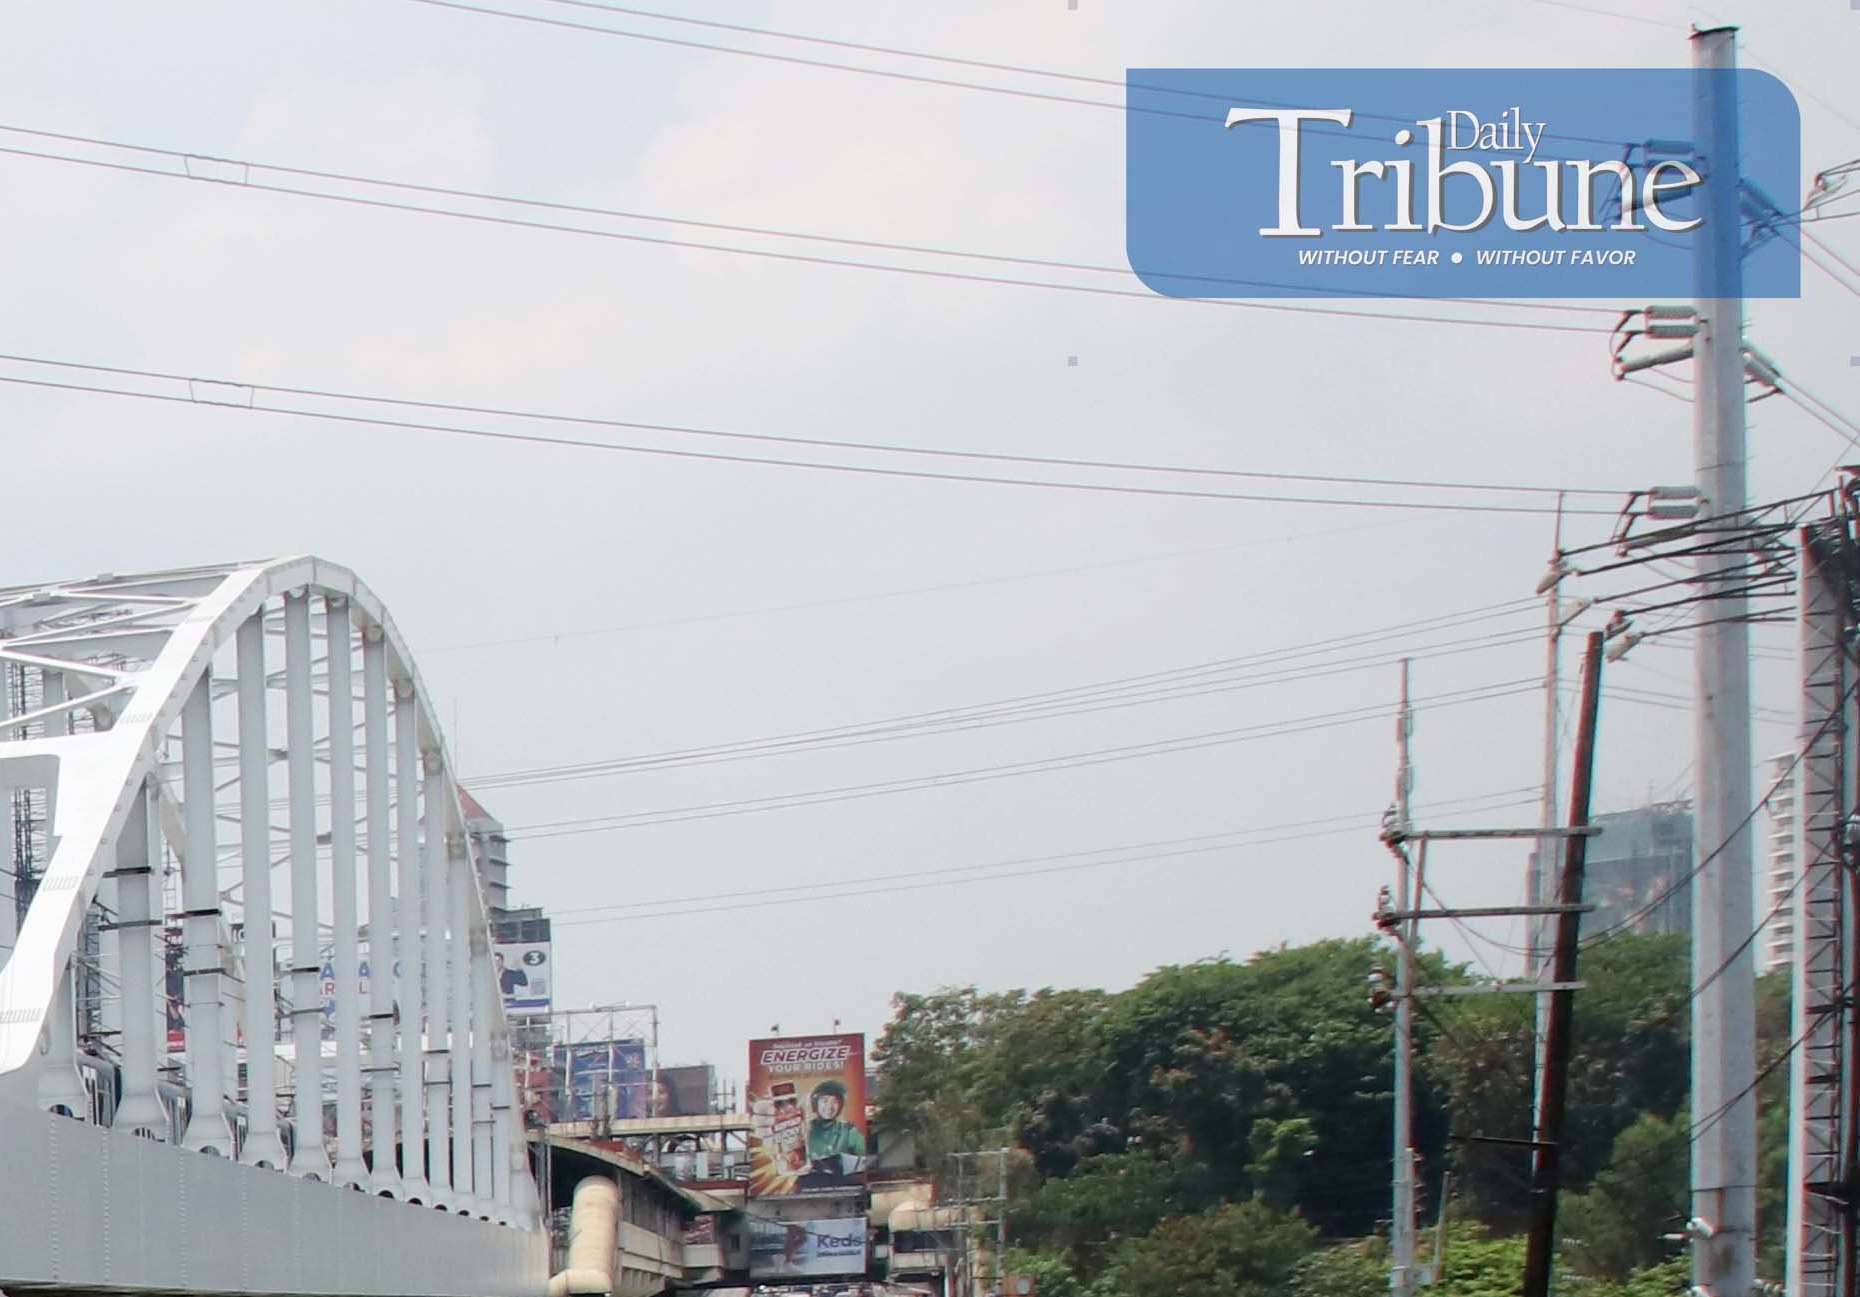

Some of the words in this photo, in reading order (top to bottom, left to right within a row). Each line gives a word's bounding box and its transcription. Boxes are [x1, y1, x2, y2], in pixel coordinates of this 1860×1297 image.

[762, 1046, 849, 1064] ENERGIZE
[769, 1063, 800, 1073] YOUR
[817, 1233, 866, 1248] Keds
